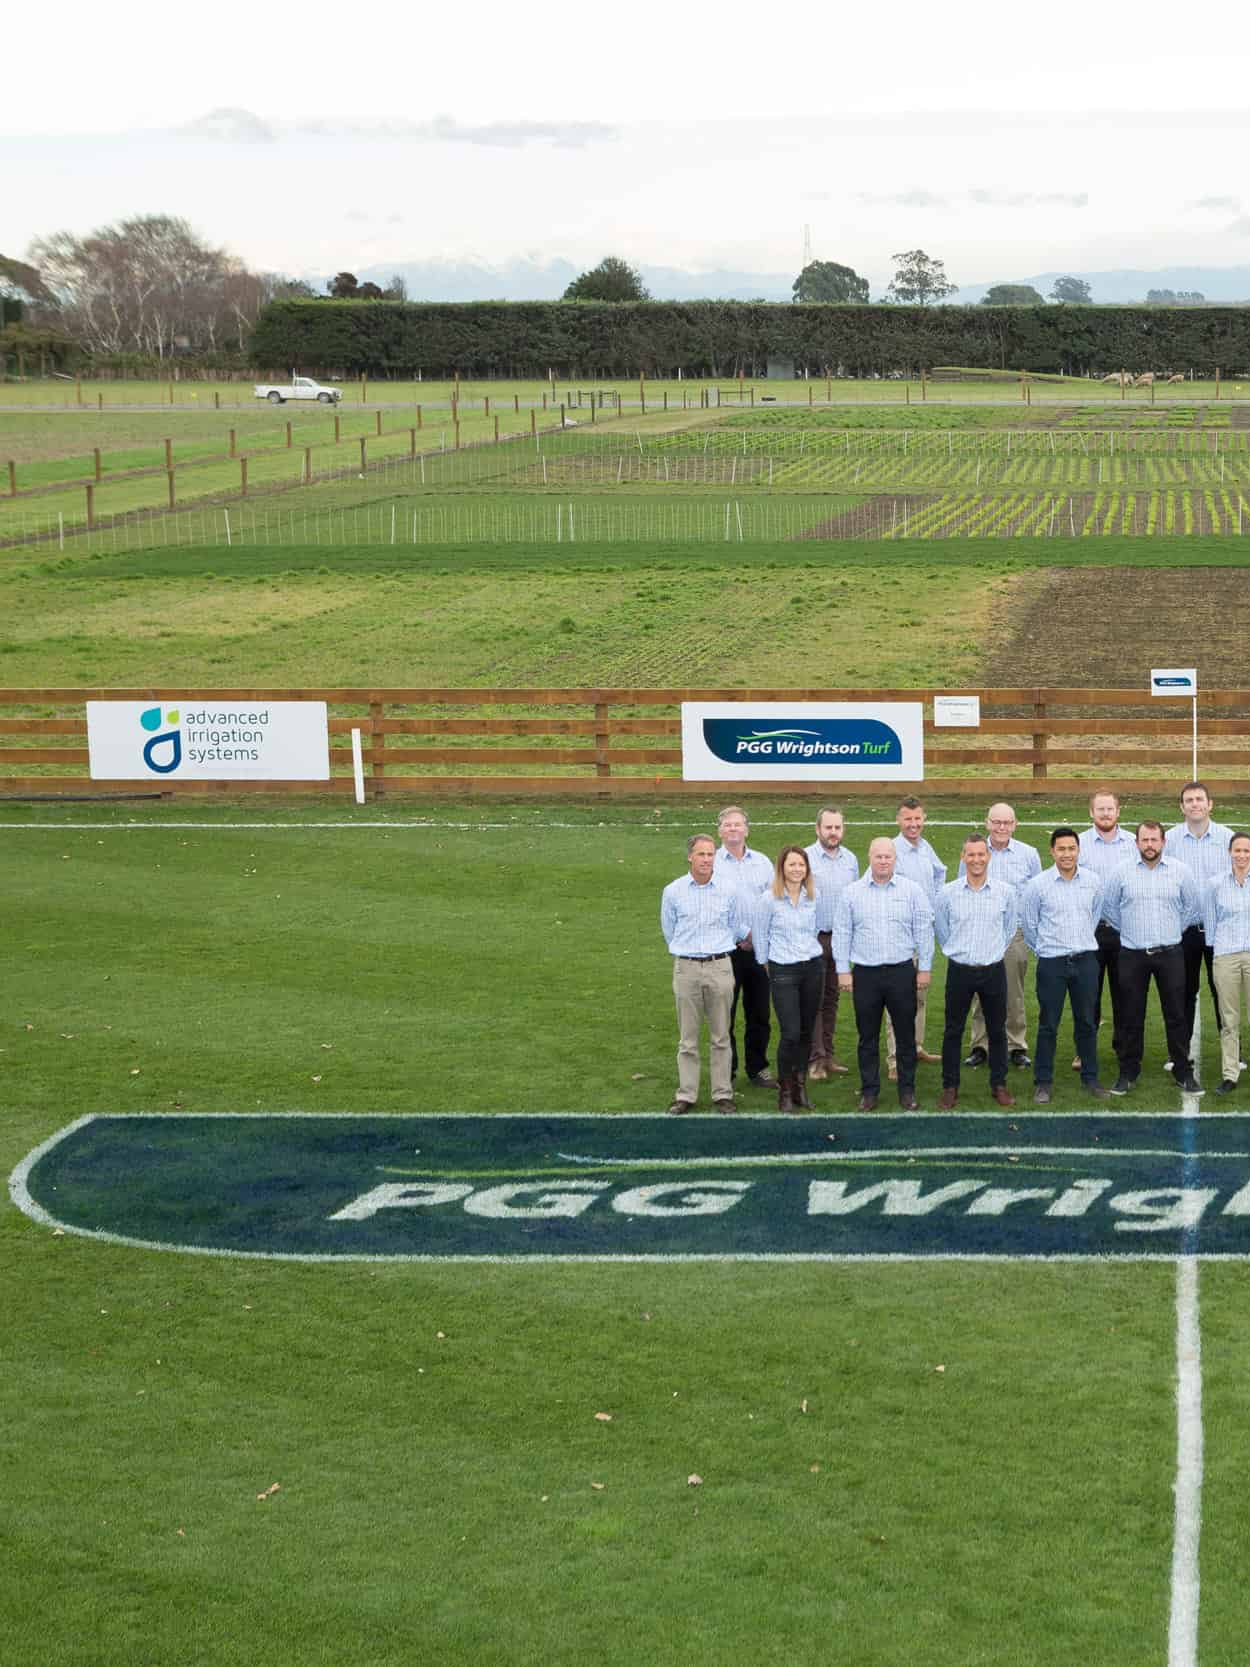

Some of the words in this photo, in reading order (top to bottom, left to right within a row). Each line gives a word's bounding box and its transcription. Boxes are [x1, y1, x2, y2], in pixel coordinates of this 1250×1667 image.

[186, 710, 269, 725] advanced
[187, 728, 263, 745] irrigation
[188, 746, 259, 763] systems
[736, 741, 773, 754] PGG
[776, 741, 860, 757] Wrightson
[862, 741, 891, 754] Turf
[328, 1179, 758, 1221] PGG
